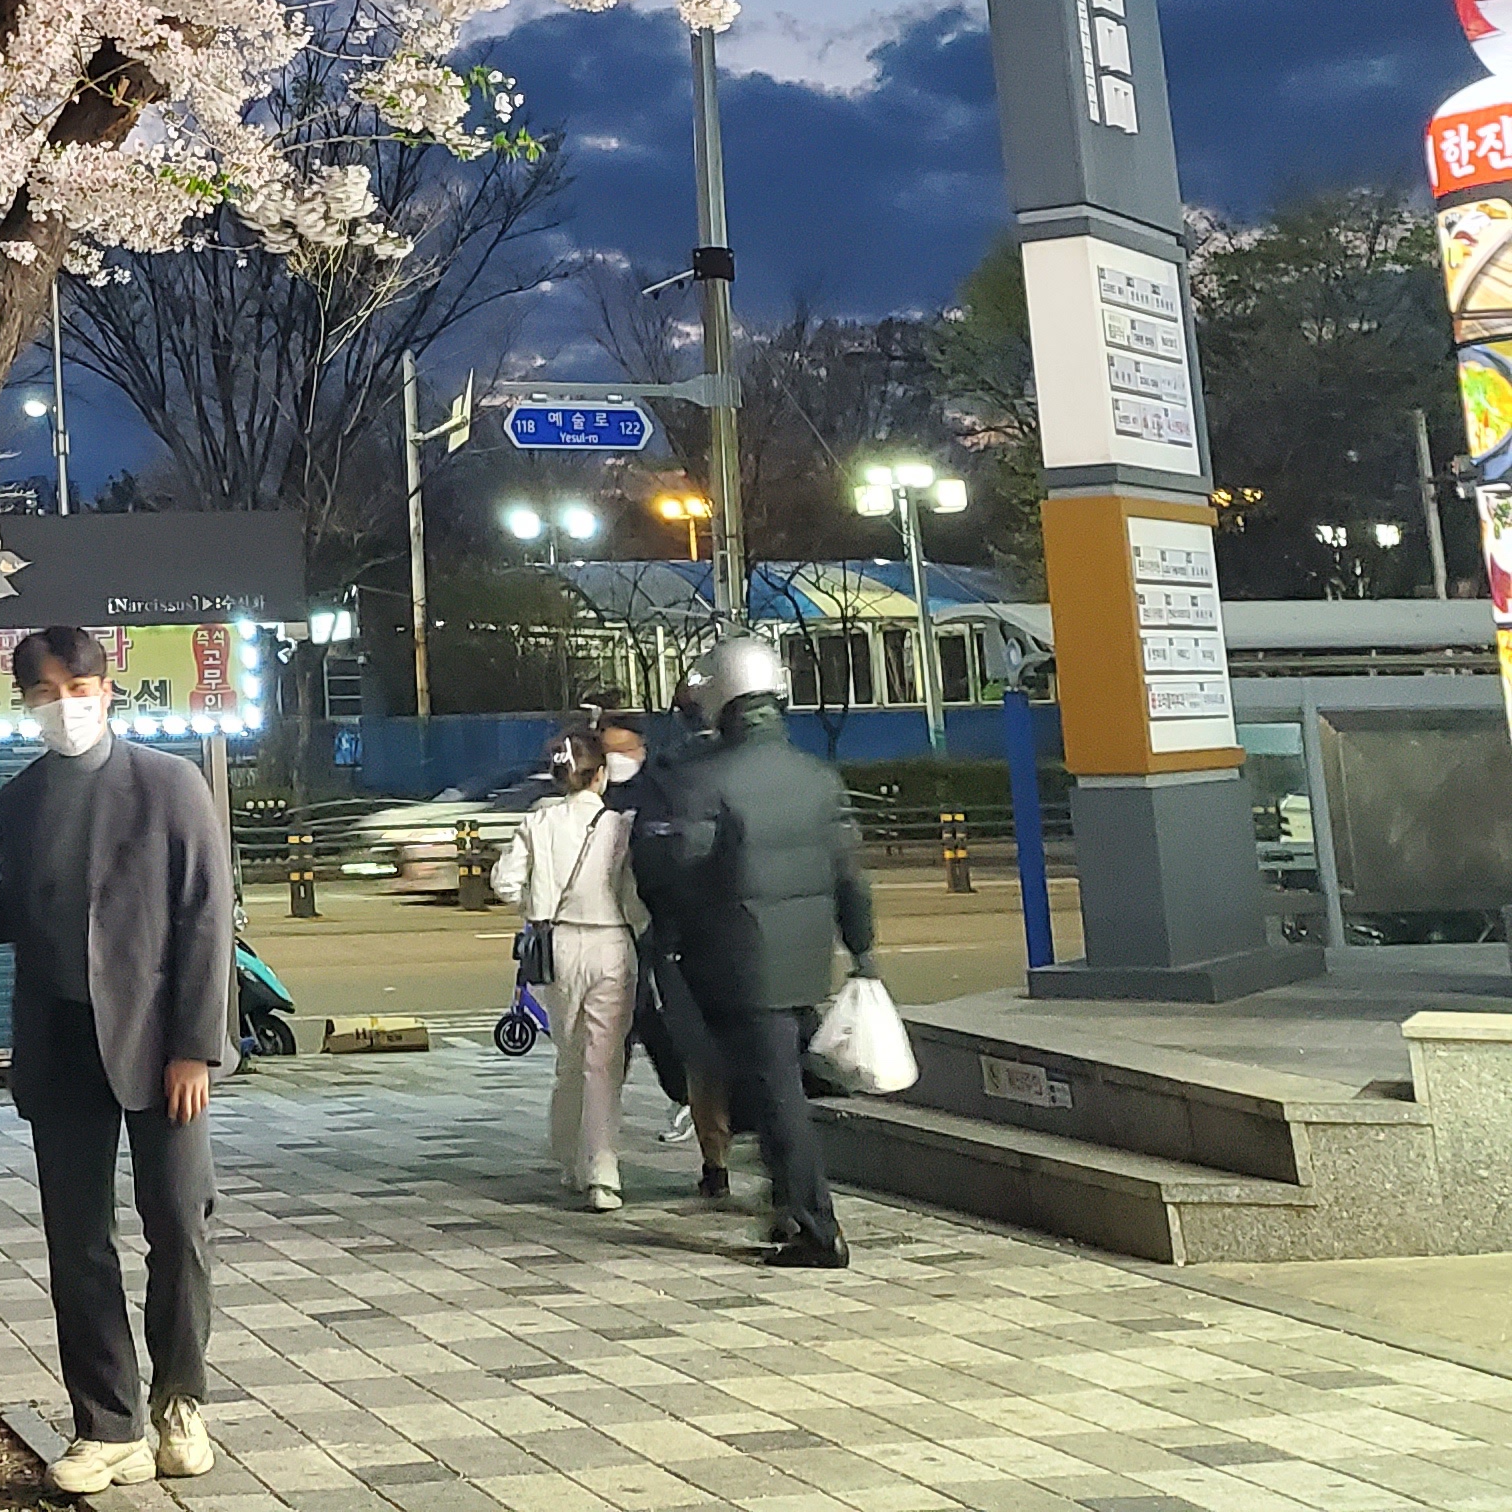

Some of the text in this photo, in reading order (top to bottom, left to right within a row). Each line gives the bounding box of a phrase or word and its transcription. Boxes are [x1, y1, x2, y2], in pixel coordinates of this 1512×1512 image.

[515, 411, 641, 435] 118 예술로 122
[560, 432, 598, 444] Yesul-ro
[196, 630, 225, 648] 즉석
